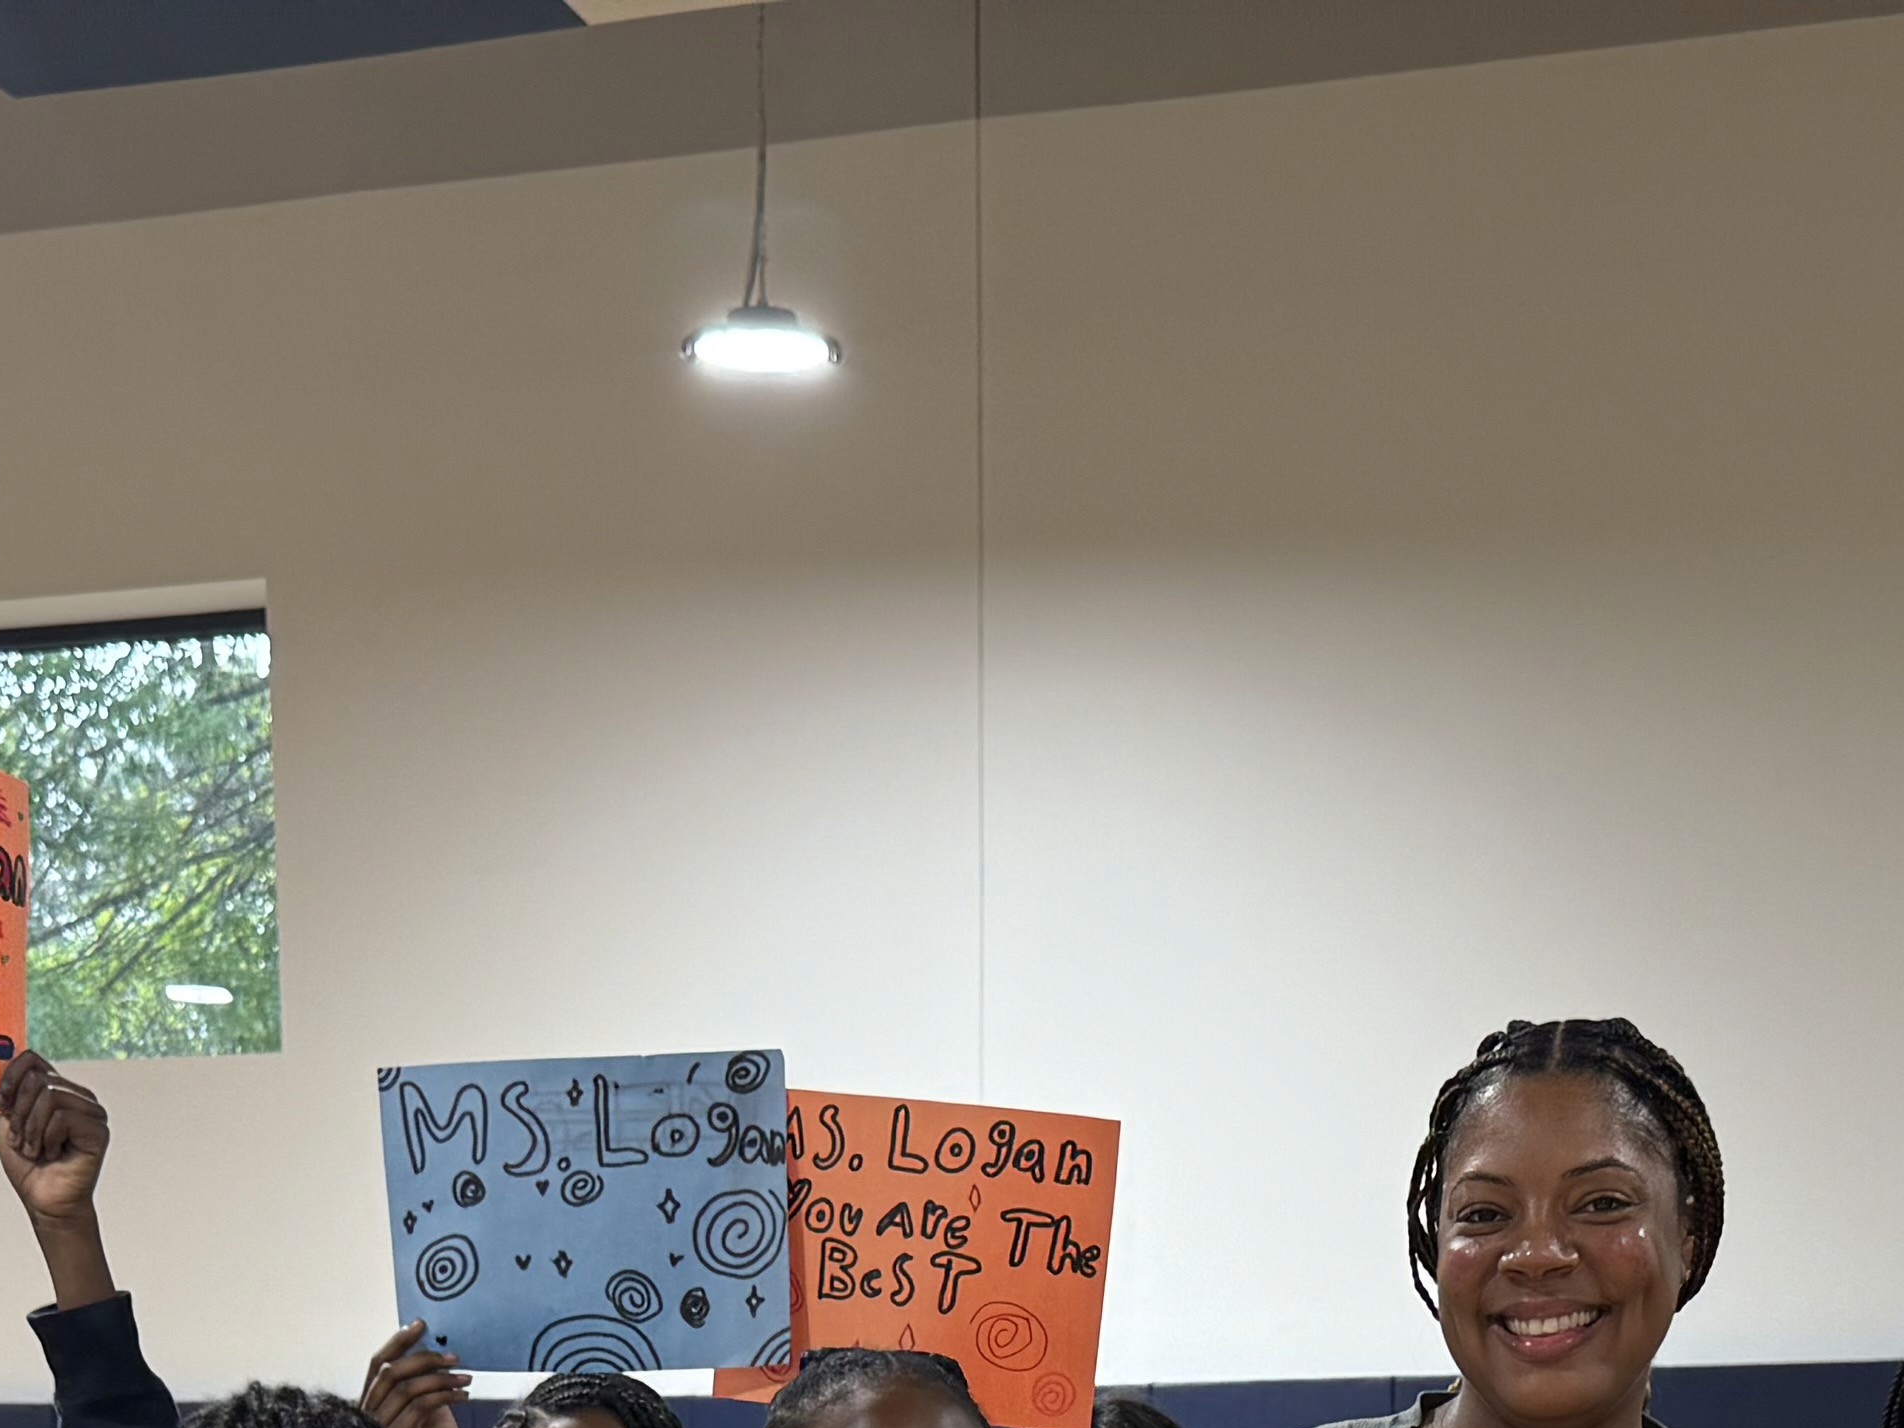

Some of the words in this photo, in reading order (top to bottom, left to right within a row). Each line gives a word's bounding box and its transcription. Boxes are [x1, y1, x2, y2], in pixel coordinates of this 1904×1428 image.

[593, 1074, 787, 1168] Logan
[887, 1103, 1094, 1186] Logan
[1001, 1208, 1102, 1279] The
